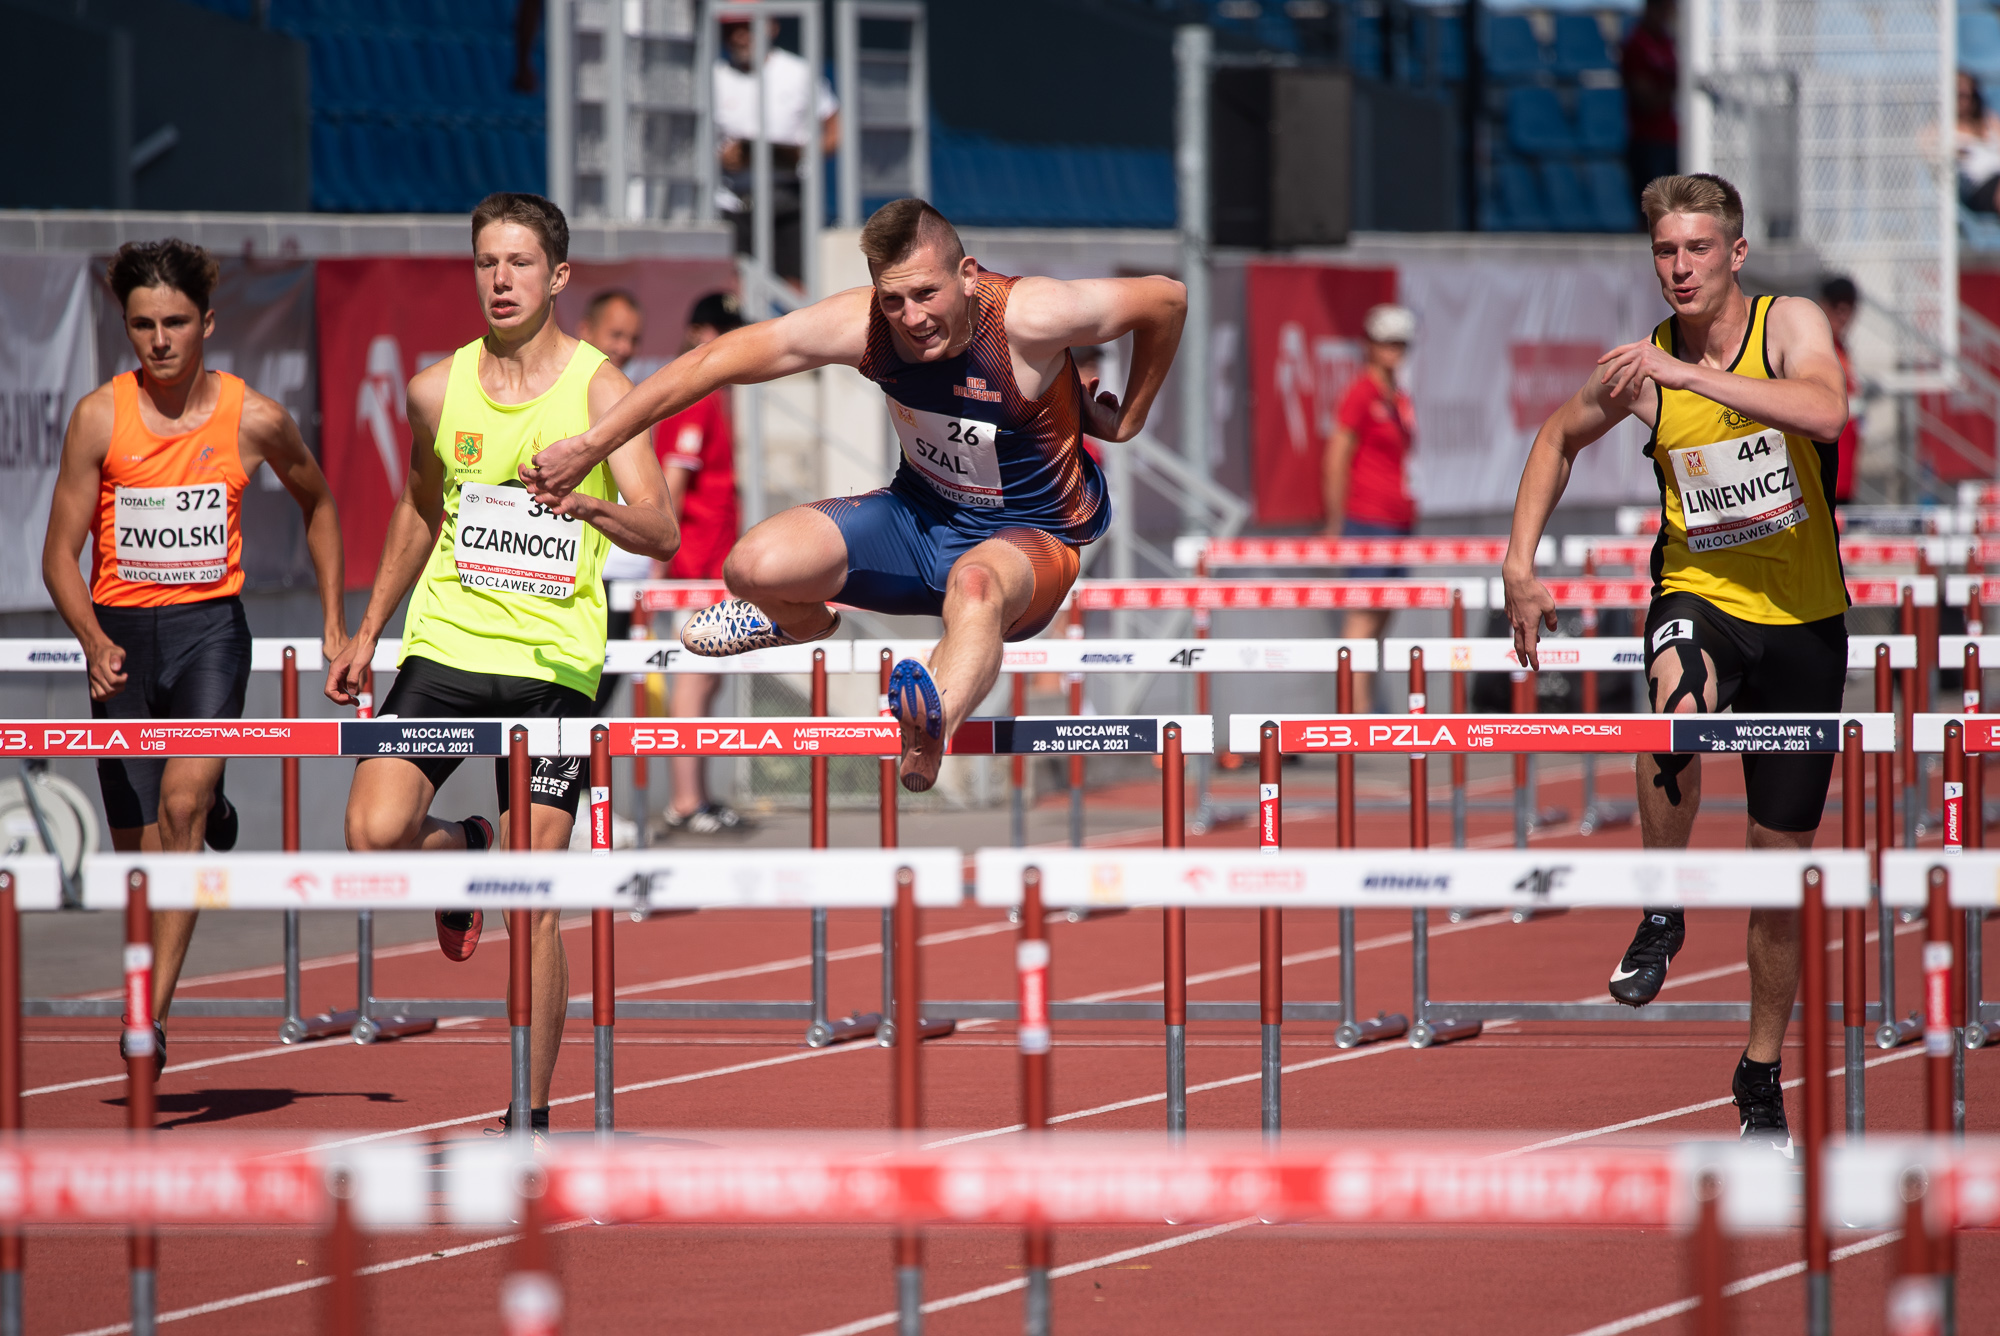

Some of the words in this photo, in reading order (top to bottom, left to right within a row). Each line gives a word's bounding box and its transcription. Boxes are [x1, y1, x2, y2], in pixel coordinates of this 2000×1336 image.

[966, 377, 986, 390] MKS
[947, 422, 979, 446] 26
[1737, 436, 1771, 462] 44
[916, 438, 968, 475] SZAL
[1686, 466, 1794, 514] LINIEWICZ
[176, 489, 220, 511] 372
[969, 496, 996, 506] 2021
[1766, 507, 1788, 519] POLSKI
[1695, 523, 1773, 550] WŁOCŁAWEK
[1776, 510, 1802, 529] 2021
[120, 525, 224, 549] ZWOLSKI
[461, 526, 576, 561] CZARNOCKI
[200, 569, 223, 580] 2021
[488, 566, 534, 577] MISTRZOSTWA
[459, 573, 535, 592] WŁOCŁAWEK
[540, 584, 566, 597] 2021
[1659, 621, 1684, 640] 4
[140, 728, 240, 738] MISTRZOSTWA
[243, 728, 290, 738] POLSKI
[402, 728, 474, 738] WŁOCŁAWEK
[794, 728, 894, 738] MISTRZOSTWA
[1056, 725, 1130, 737] WŁOCŁAWEK
[1306, 726, 1358, 747] 53.
[1370, 725, 1456, 746] PZLA
[1467, 724, 1570, 735] MISTRZOSTWA
[1572, 725, 1622, 736] POLSKI
[1736, 726, 1811, 737] WŁOCŁAWEK
[0, 730, 33, 750] 3.
[44, 729, 129, 750] PZLA
[140, 741, 166, 750] U18
[634, 729, 686, 749] 53.
[697, 729, 782, 749] PZLA
[794, 741, 819, 750] U18
[1033, 740, 1064, 751] 28-30
[1068, 740, 1100, 751] LIPCA
[1103, 739, 1129, 750] 2021
[1467, 738, 1493, 747] U18
[1712, 740, 1744, 751] 28-30
[1747, 740, 1781, 750] LIPCA
[1784, 740, 1810, 750] 2021
[378, 742, 410, 753] 28-30
[413, 742, 446, 753] LIPCA
[448, 742, 474, 752] 2021
[531, 776, 570, 790] NIKS
[595, 807, 606, 845] polanik
[1264, 803, 1275, 842] polanik
[1948, 802, 1958, 841] polanik
